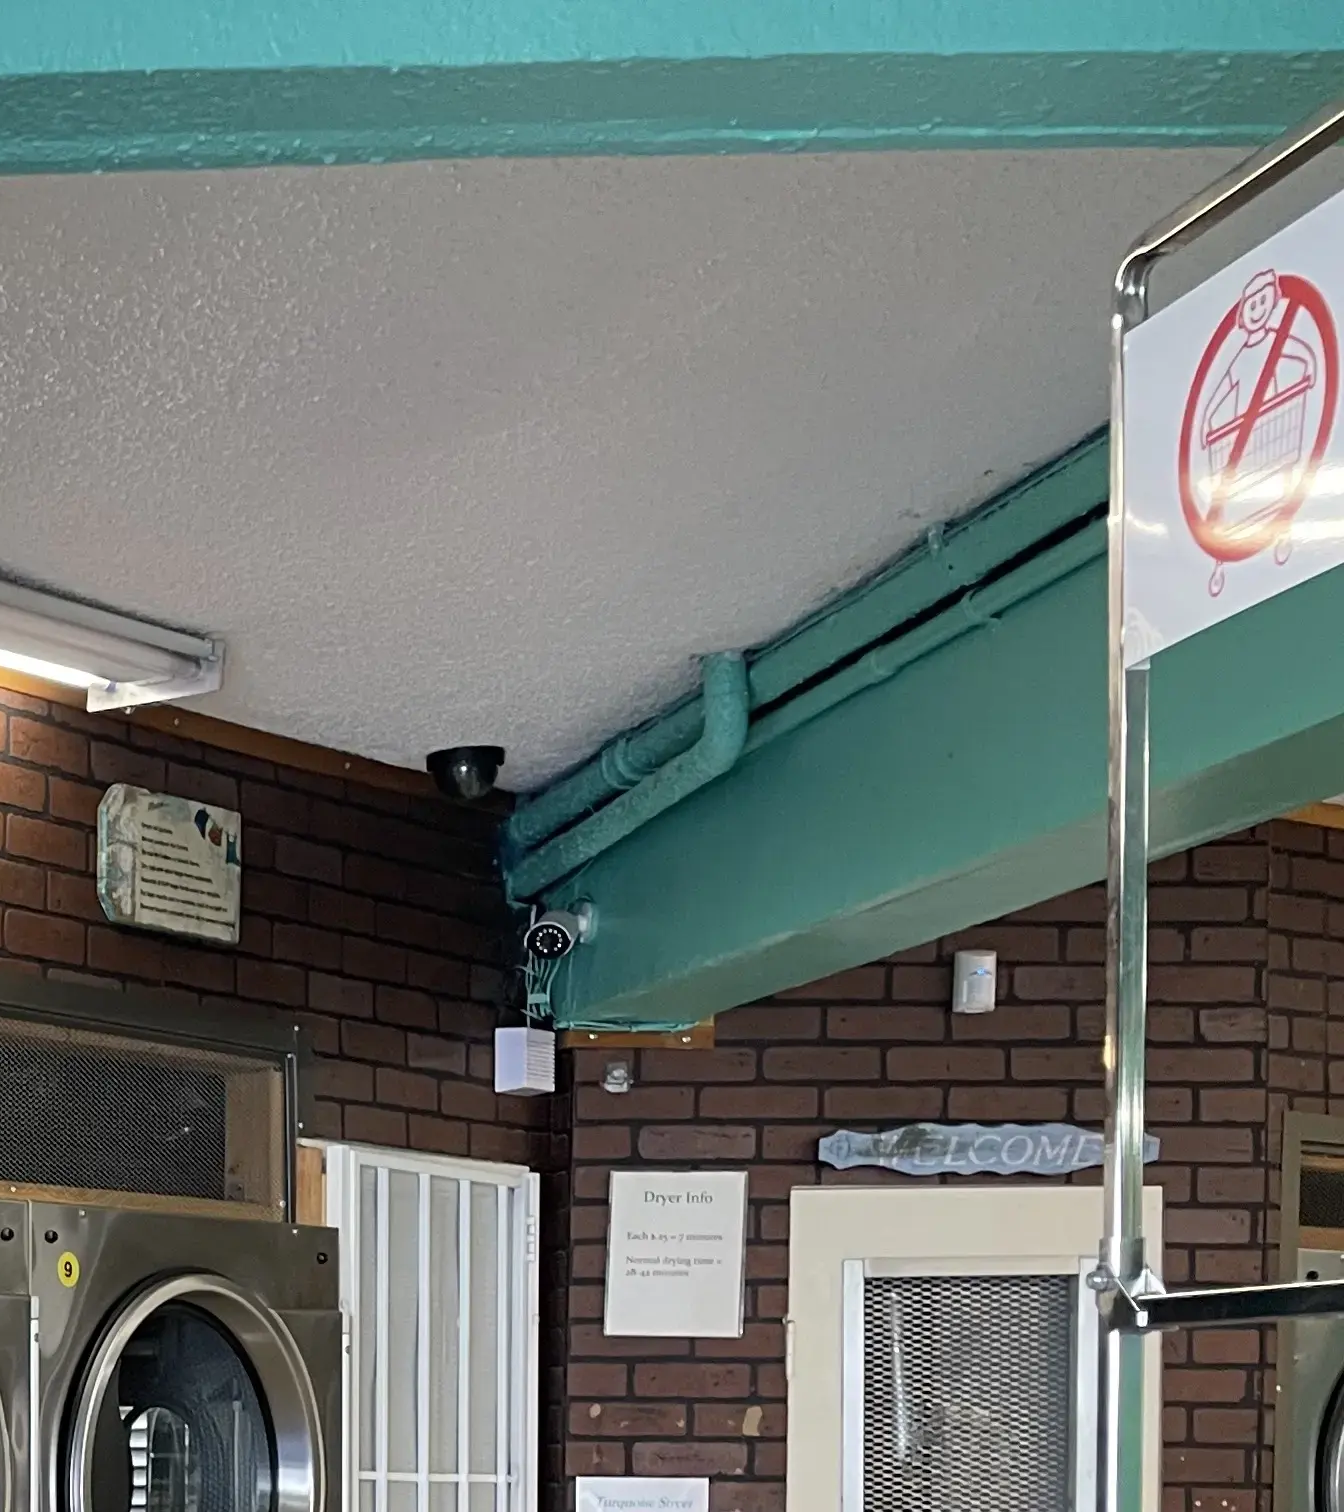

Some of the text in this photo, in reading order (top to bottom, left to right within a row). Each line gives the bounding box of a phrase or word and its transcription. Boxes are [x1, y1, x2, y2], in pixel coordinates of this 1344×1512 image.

[644, 1191, 713, 1206] Dryer Info
[627, 1231, 648, 1240] Each
[678, 1234, 684, 1243] 7
[626, 1256, 660, 1264] Normal
[663, 1256, 691, 1267] drying
[64, 1261, 72, 1278] 9
[597, 1497, 693, 1510] Turquoise Street
